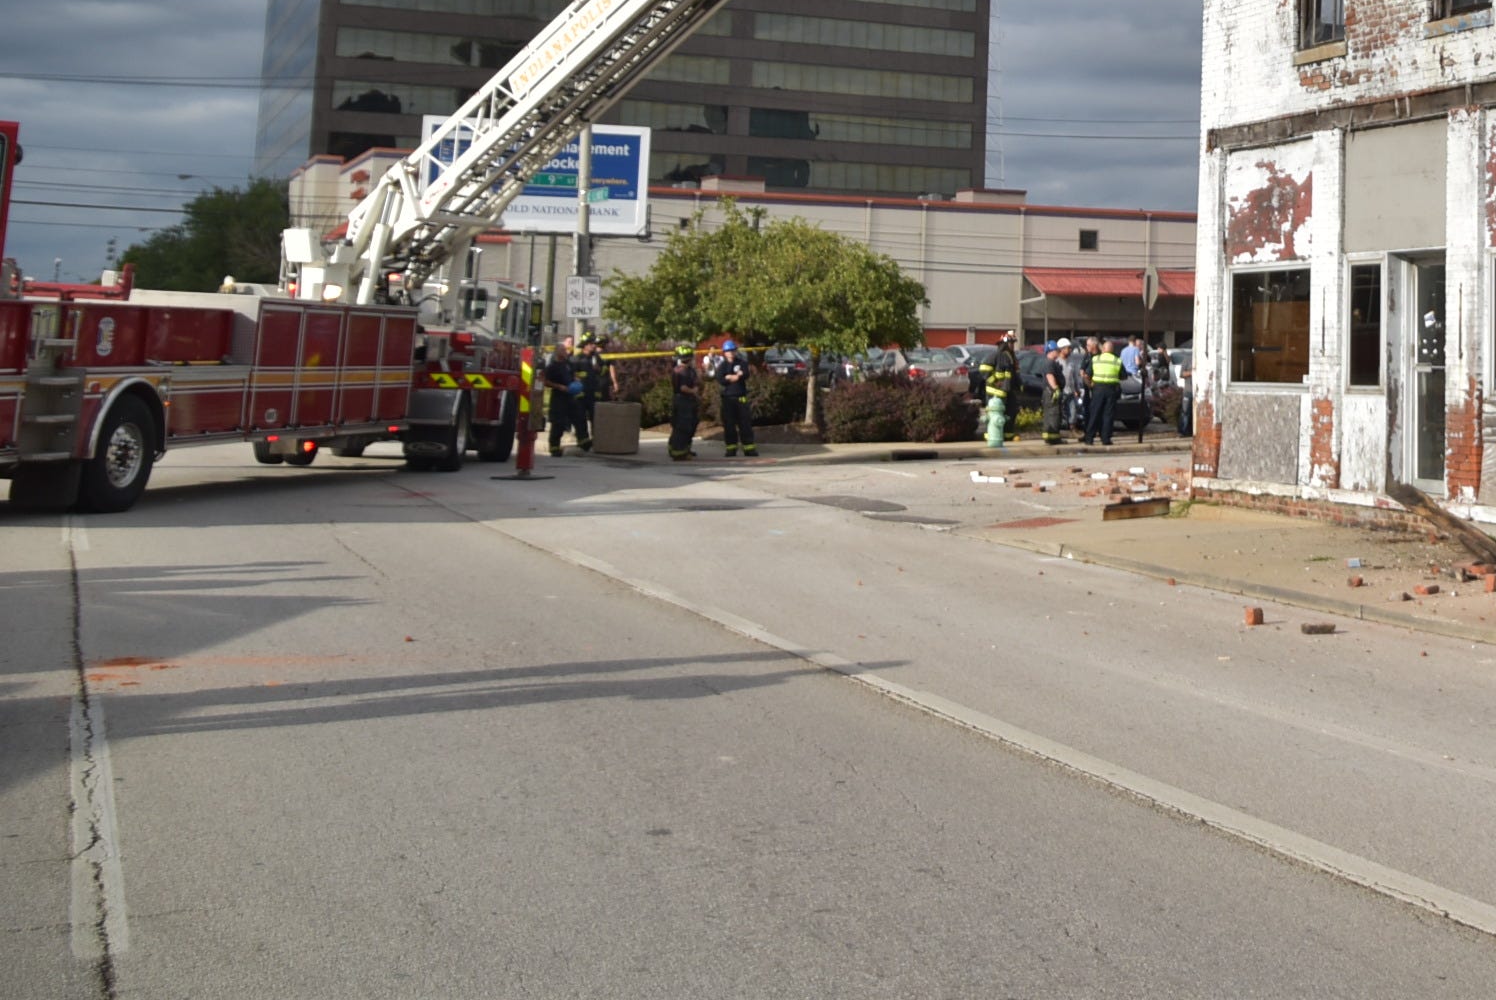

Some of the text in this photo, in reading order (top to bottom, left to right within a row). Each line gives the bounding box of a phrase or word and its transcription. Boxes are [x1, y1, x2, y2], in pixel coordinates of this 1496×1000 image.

[505, 204, 620, 217] OLD NATION BANK
[571, 306, 593, 315] ONLY
